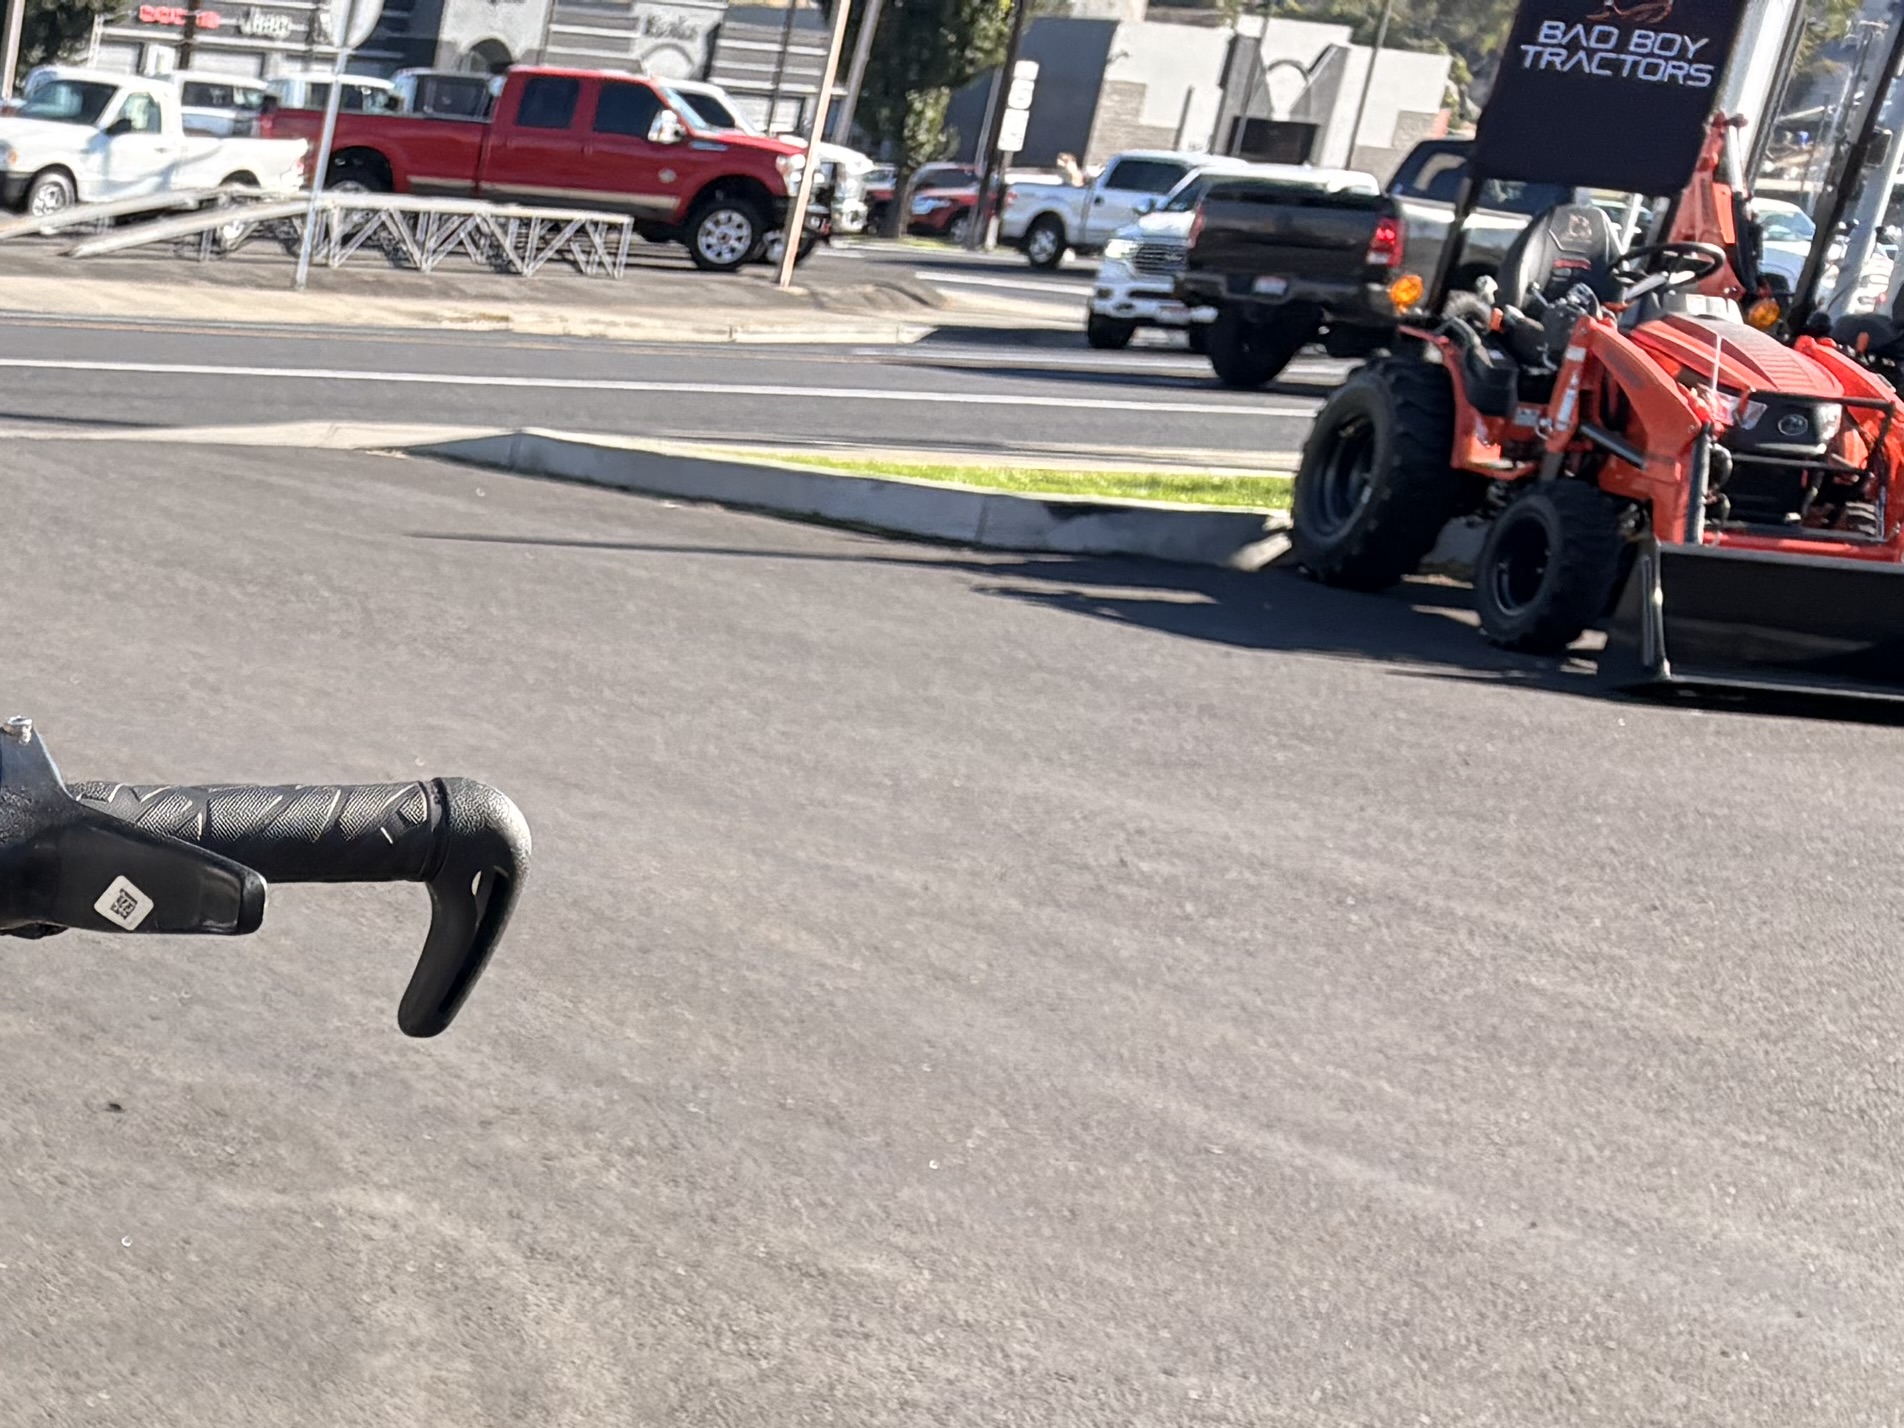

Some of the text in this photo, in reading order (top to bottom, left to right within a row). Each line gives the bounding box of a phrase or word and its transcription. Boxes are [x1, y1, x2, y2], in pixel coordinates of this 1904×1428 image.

[1538, 20, 1709, 59] BAD BOY
[1520, 44, 1714, 88] TRACTORS
